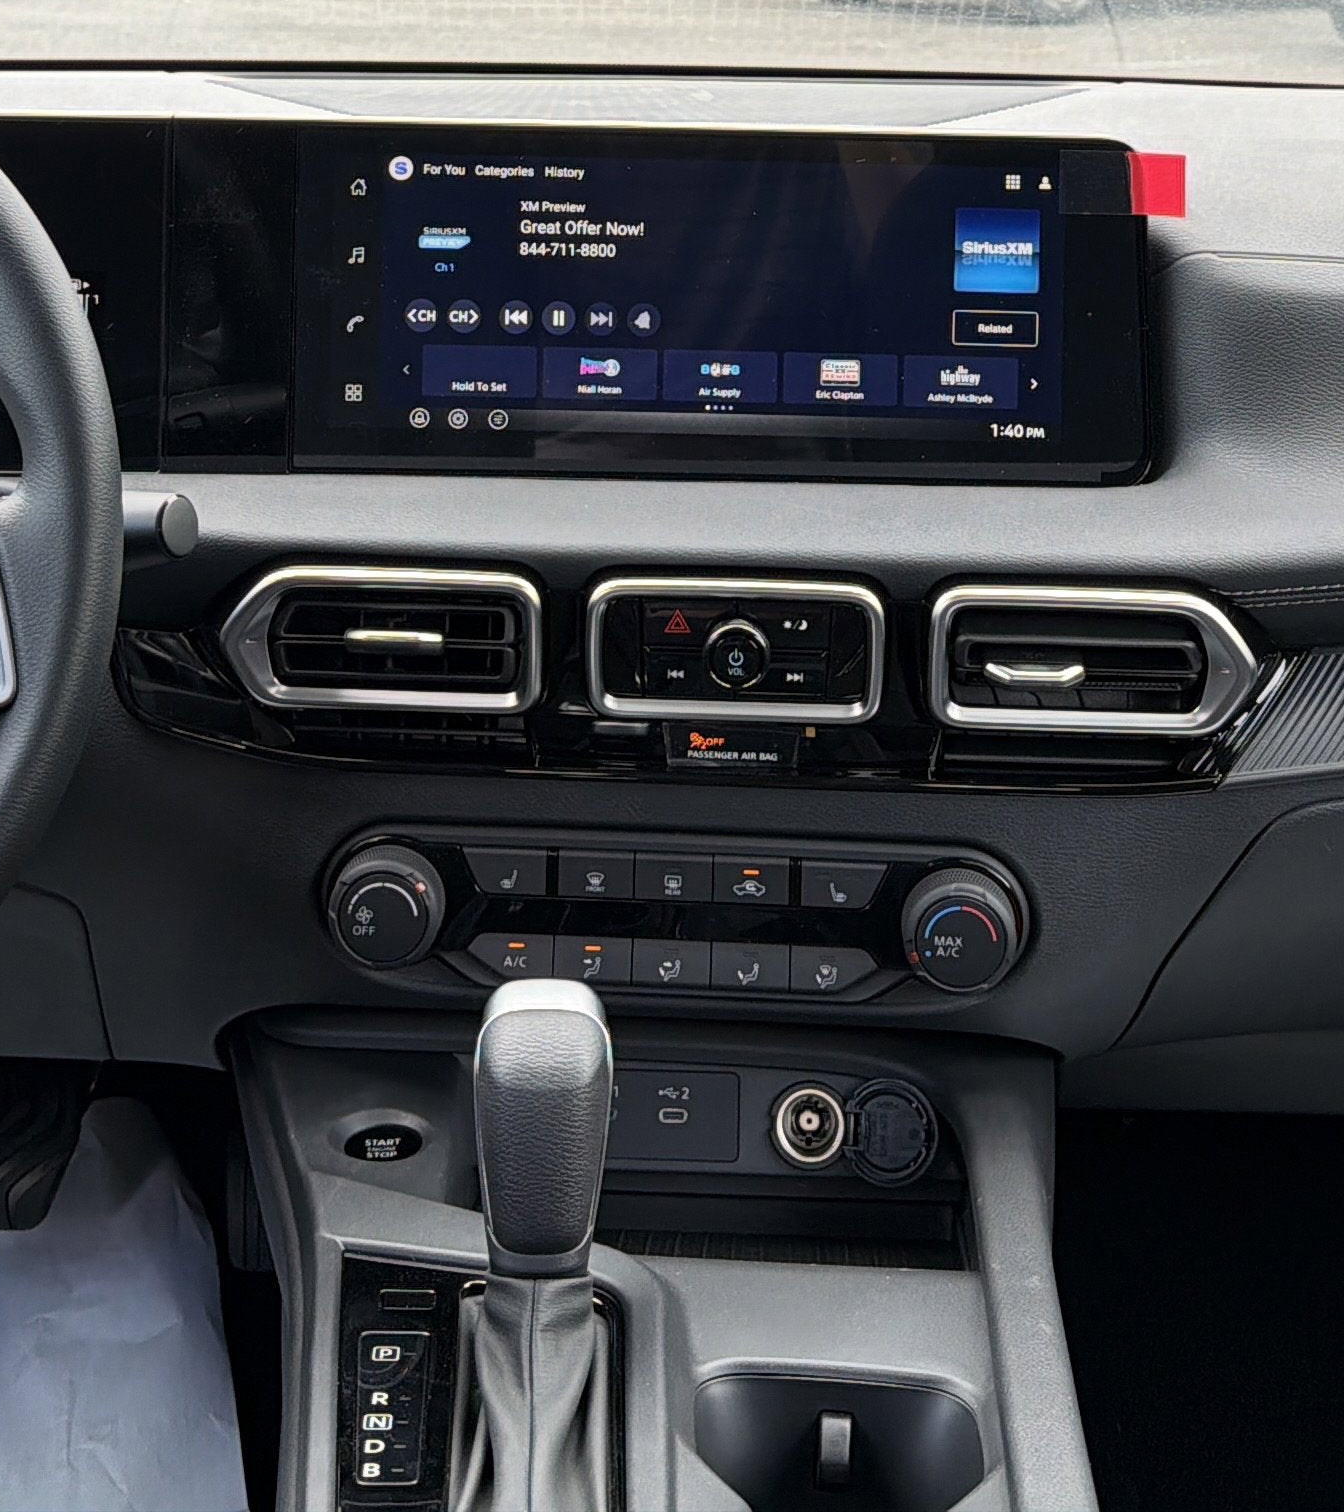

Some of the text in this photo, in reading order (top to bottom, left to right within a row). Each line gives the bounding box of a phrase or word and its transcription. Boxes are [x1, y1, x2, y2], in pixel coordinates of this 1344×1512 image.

[423, 164, 466, 176] For You
[475, 165, 535, 178] Categories
[544, 166, 585, 180] History
[520, 201, 586, 213] XM Preview
[520, 220, 645, 236] Great Offer Now!
[519, 242, 616, 258] 844-711-8800
[962, 241, 1033, 256] SiriusXM
[434, 262, 448, 272] Ch
[978, 323, 1013, 334] Related
[958, 365, 968, 374] the
[940, 370, 981, 386] highway
[452, 381, 507, 393] Hold To Set
[577, 385, 622, 394] Niall Horan
[699, 388, 742, 399] Air Supply
[815, 390, 865, 401] Eric Clapton
[927, 393, 994, 404] Ashley McBryde
[990, 423, 1045, 439] 1:40 PM
[727, 667, 745, 676] VOL
[706, 738, 725, 747] OFF
[687, 750, 778, 762] PASSENGER AIR BAG
[352, 925, 376, 936] OFF
[934, 936, 963, 947] MAX
[936, 947, 960, 958] A/C
[503, 956, 527, 968] A/C
[681, 1087, 690, 1100] 2
[364, 1137, 402, 1147] START
[366, 1151, 398, 1159] STOP
[371, 1391, 389, 1405] R
[368, 1415, 388, 1428] N
[363, 1439, 386, 1454] D
[362, 1463, 381, 1478] B
